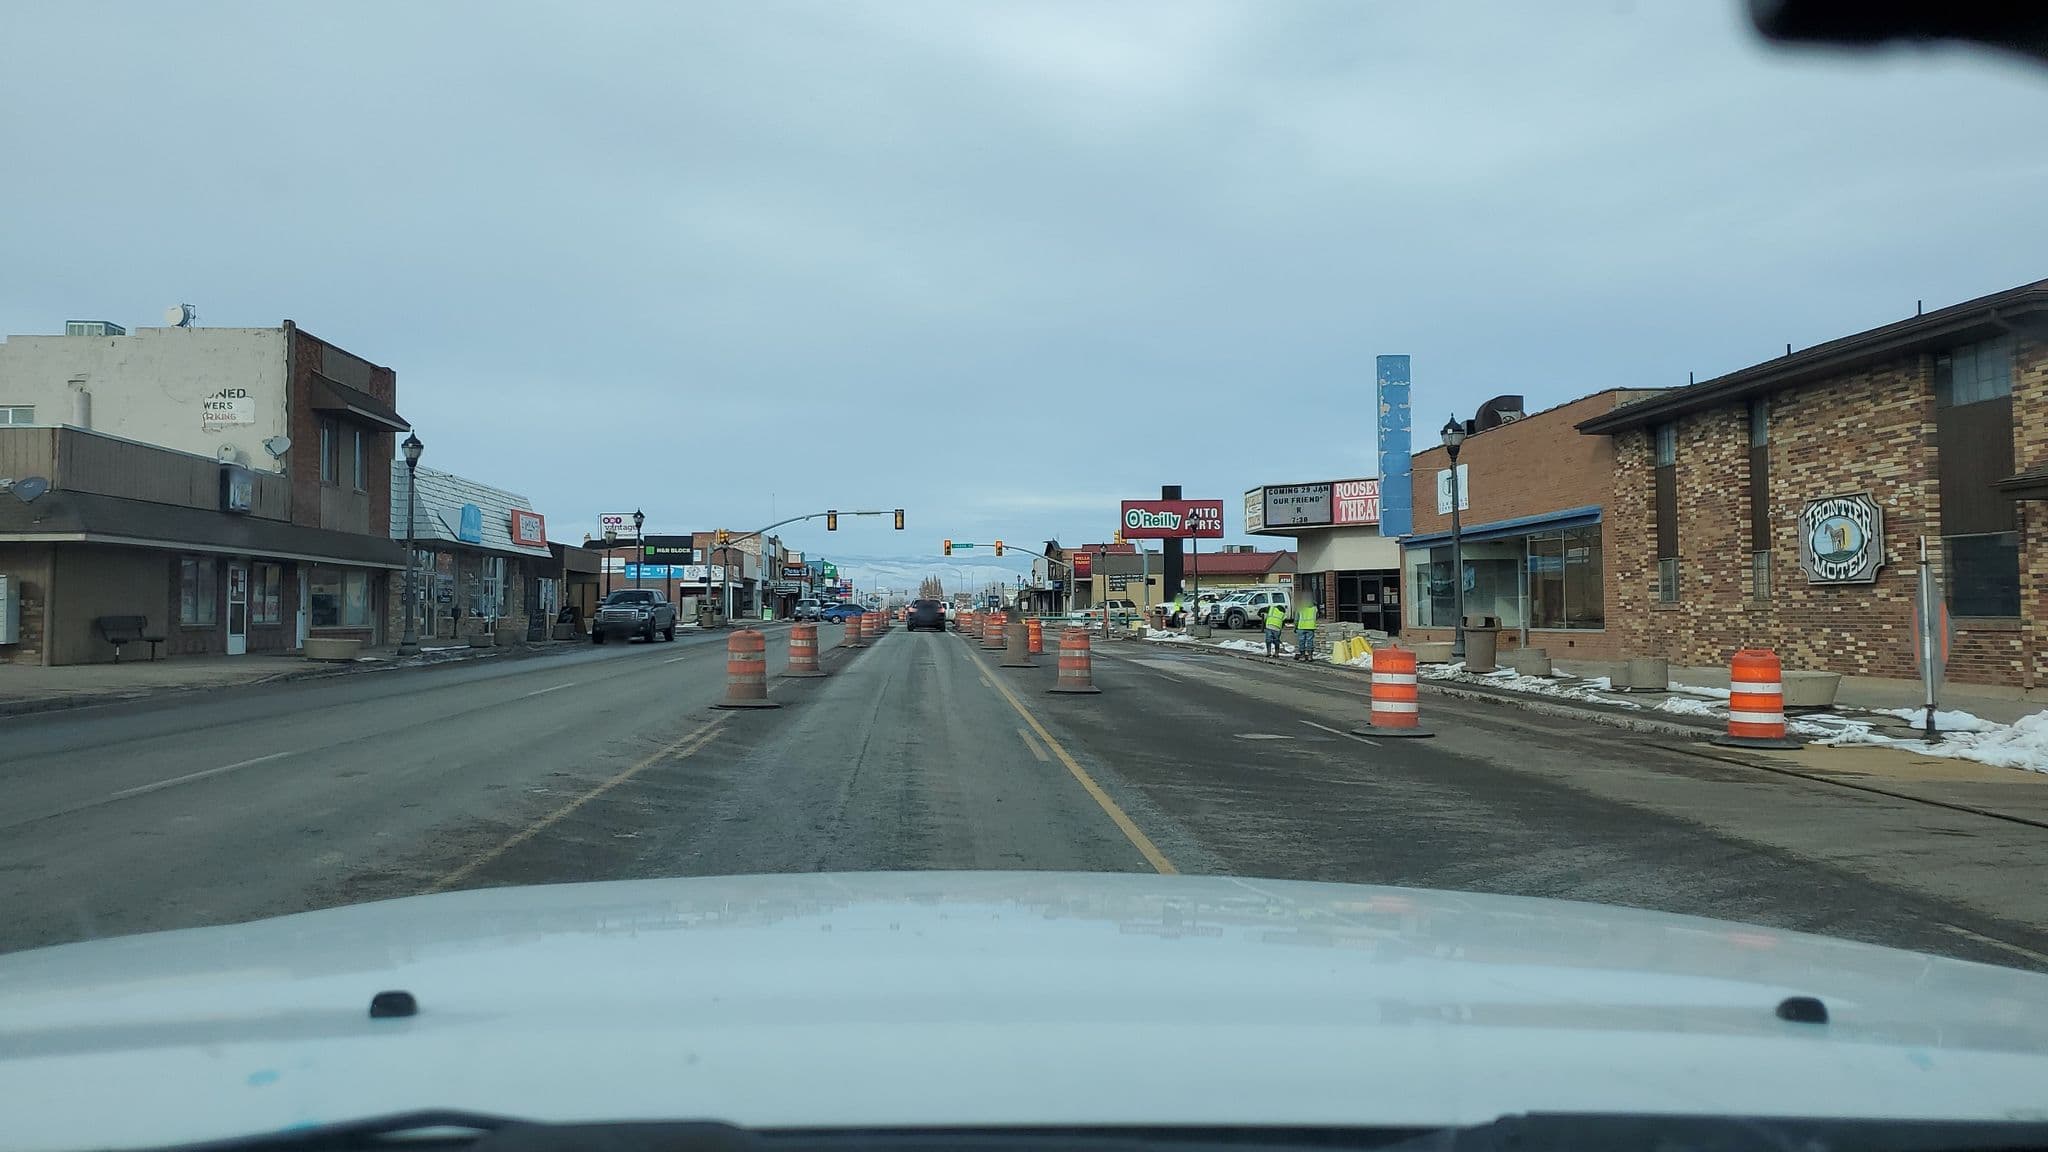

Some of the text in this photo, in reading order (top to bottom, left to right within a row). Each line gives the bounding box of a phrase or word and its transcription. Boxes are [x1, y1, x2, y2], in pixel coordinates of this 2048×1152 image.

[1268, 487, 1299, 496] COMING
[1313, 485, 1329, 494] JAN
[1273, 497, 1289, 505] OUR
[1125, 508, 1181, 530] O'Reilly
[1187, 508, 1218, 519] AUTO
[1184, 519, 1221, 530] PRTS
[1805, 496, 1872, 552] FRONTIER
[1813, 550, 1867, 579] MOTEL
